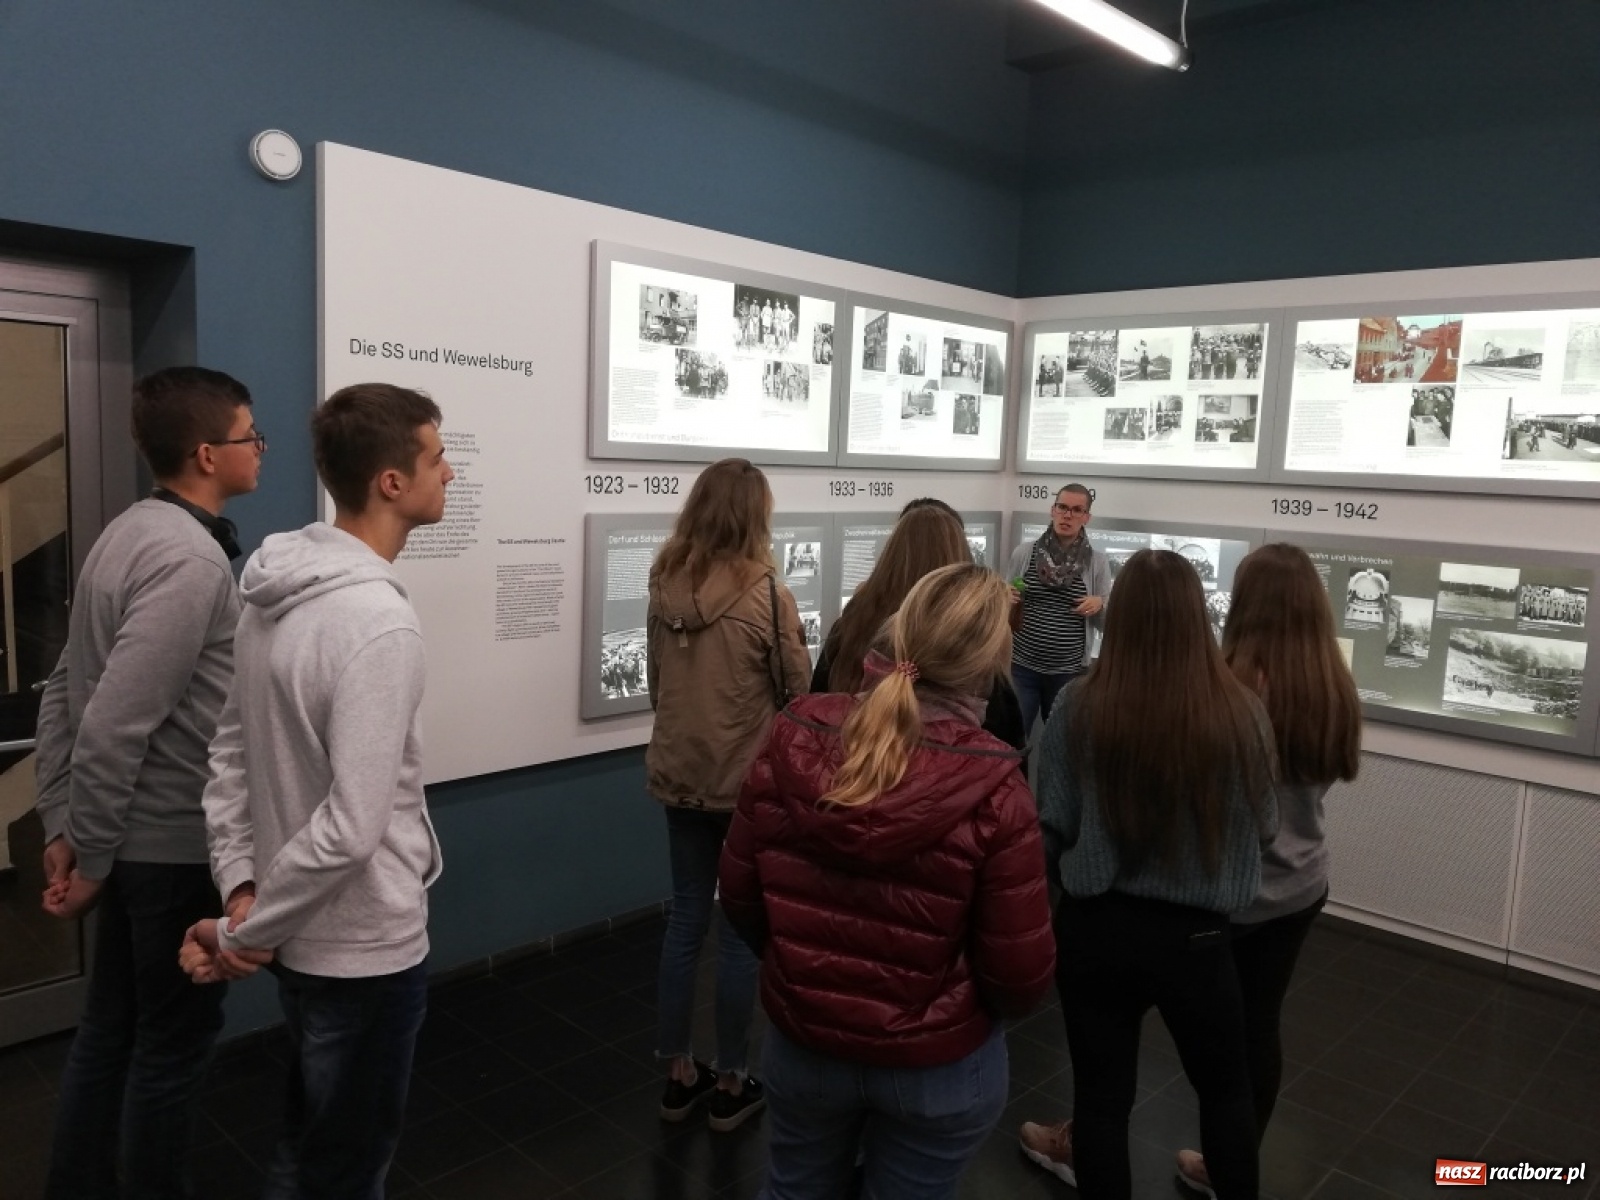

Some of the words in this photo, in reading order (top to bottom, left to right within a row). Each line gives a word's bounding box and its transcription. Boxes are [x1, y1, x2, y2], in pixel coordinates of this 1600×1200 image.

[349, 338, 377, 357] Die
[381, 341, 404, 360] SS
[408, 347, 439, 363] und
[443, 348, 534, 377] Wewelsburg
[585, 474, 624, 494] 1923
[643, 475, 679, 494] 1932
[829, 480, 856, 497] 1933
[868, 481, 894, 497] 1936
[1018, 485, 1048, 499] 1936
[1271, 498, 1312, 516] 1939
[1334, 501, 1379, 520] 1942
